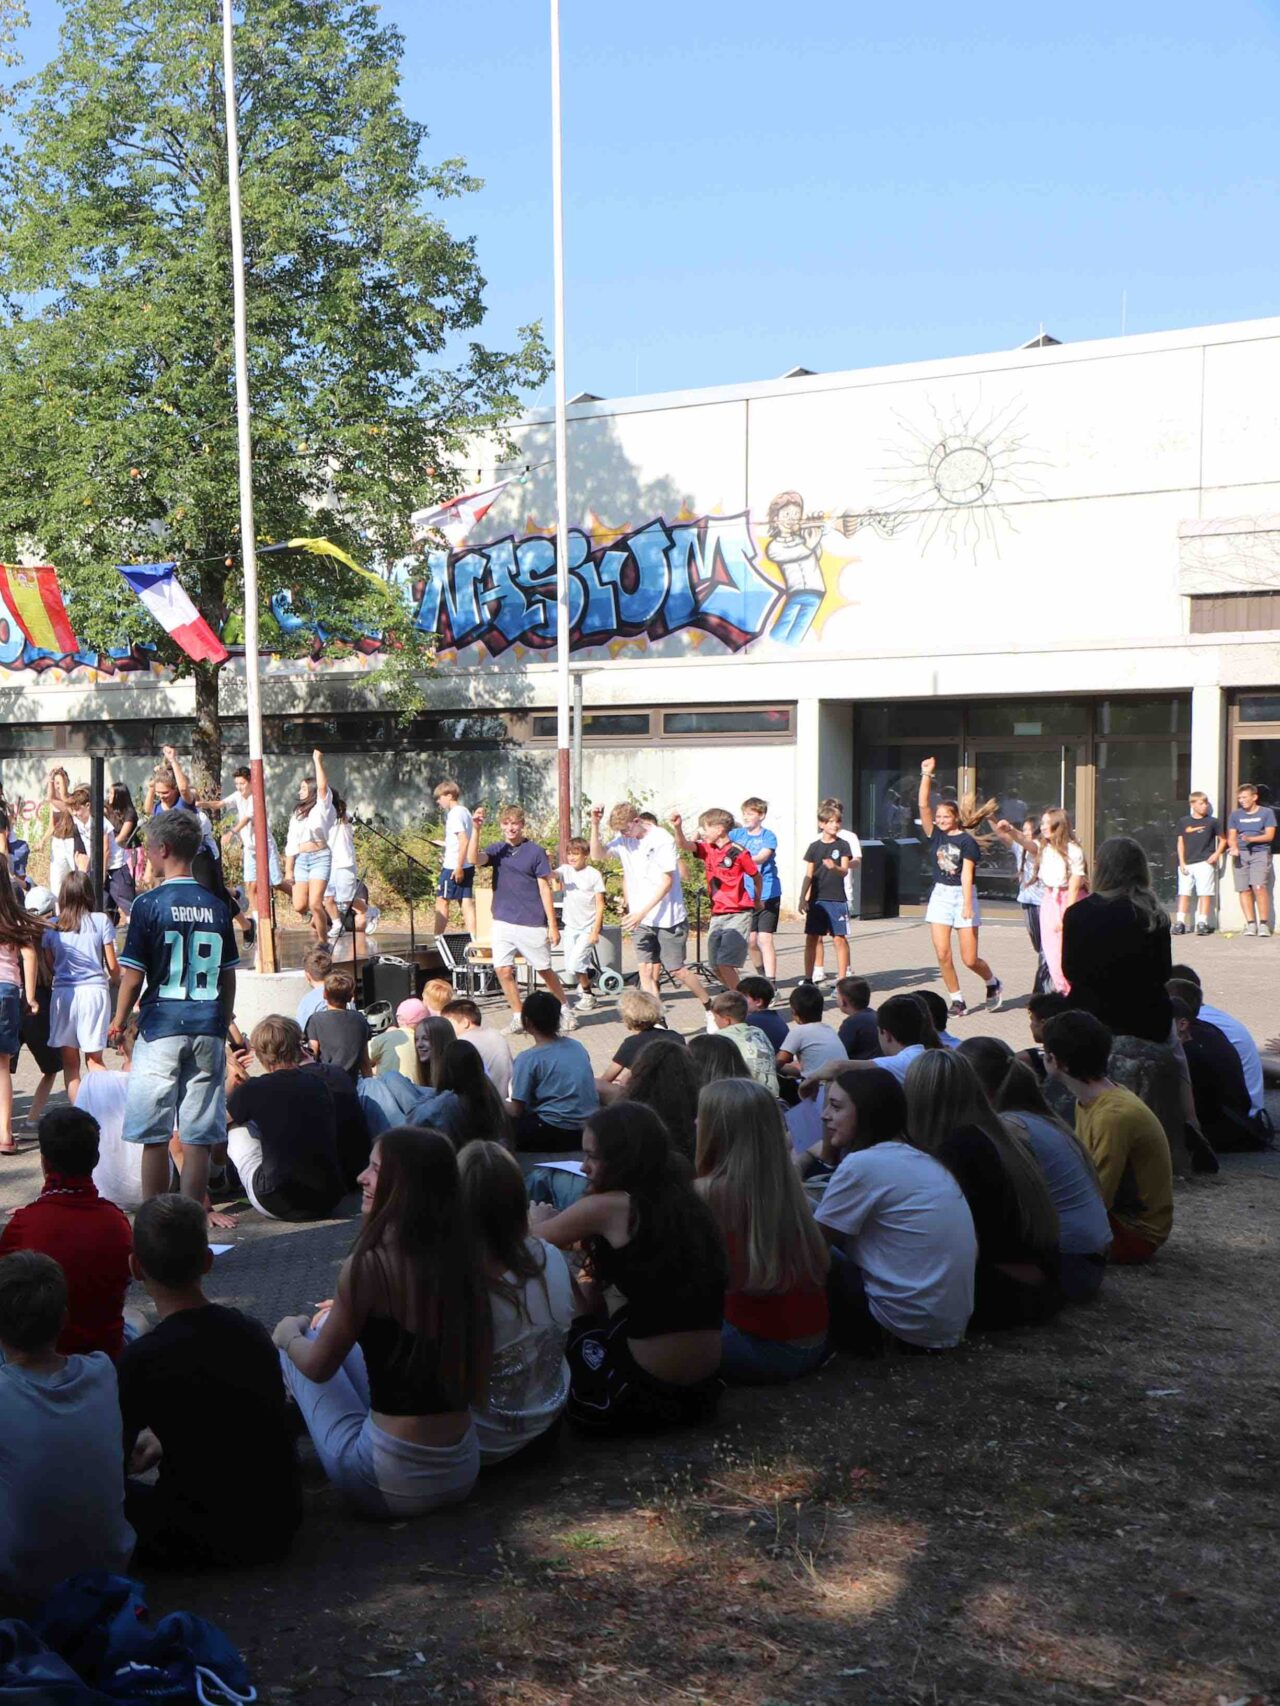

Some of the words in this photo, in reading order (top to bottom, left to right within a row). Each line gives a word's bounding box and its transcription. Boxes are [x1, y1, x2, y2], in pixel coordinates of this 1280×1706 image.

[270, 511, 785, 656] NASIUM
[171, 906, 214, 923] BROWN
[158, 930, 223, 1000] 18
